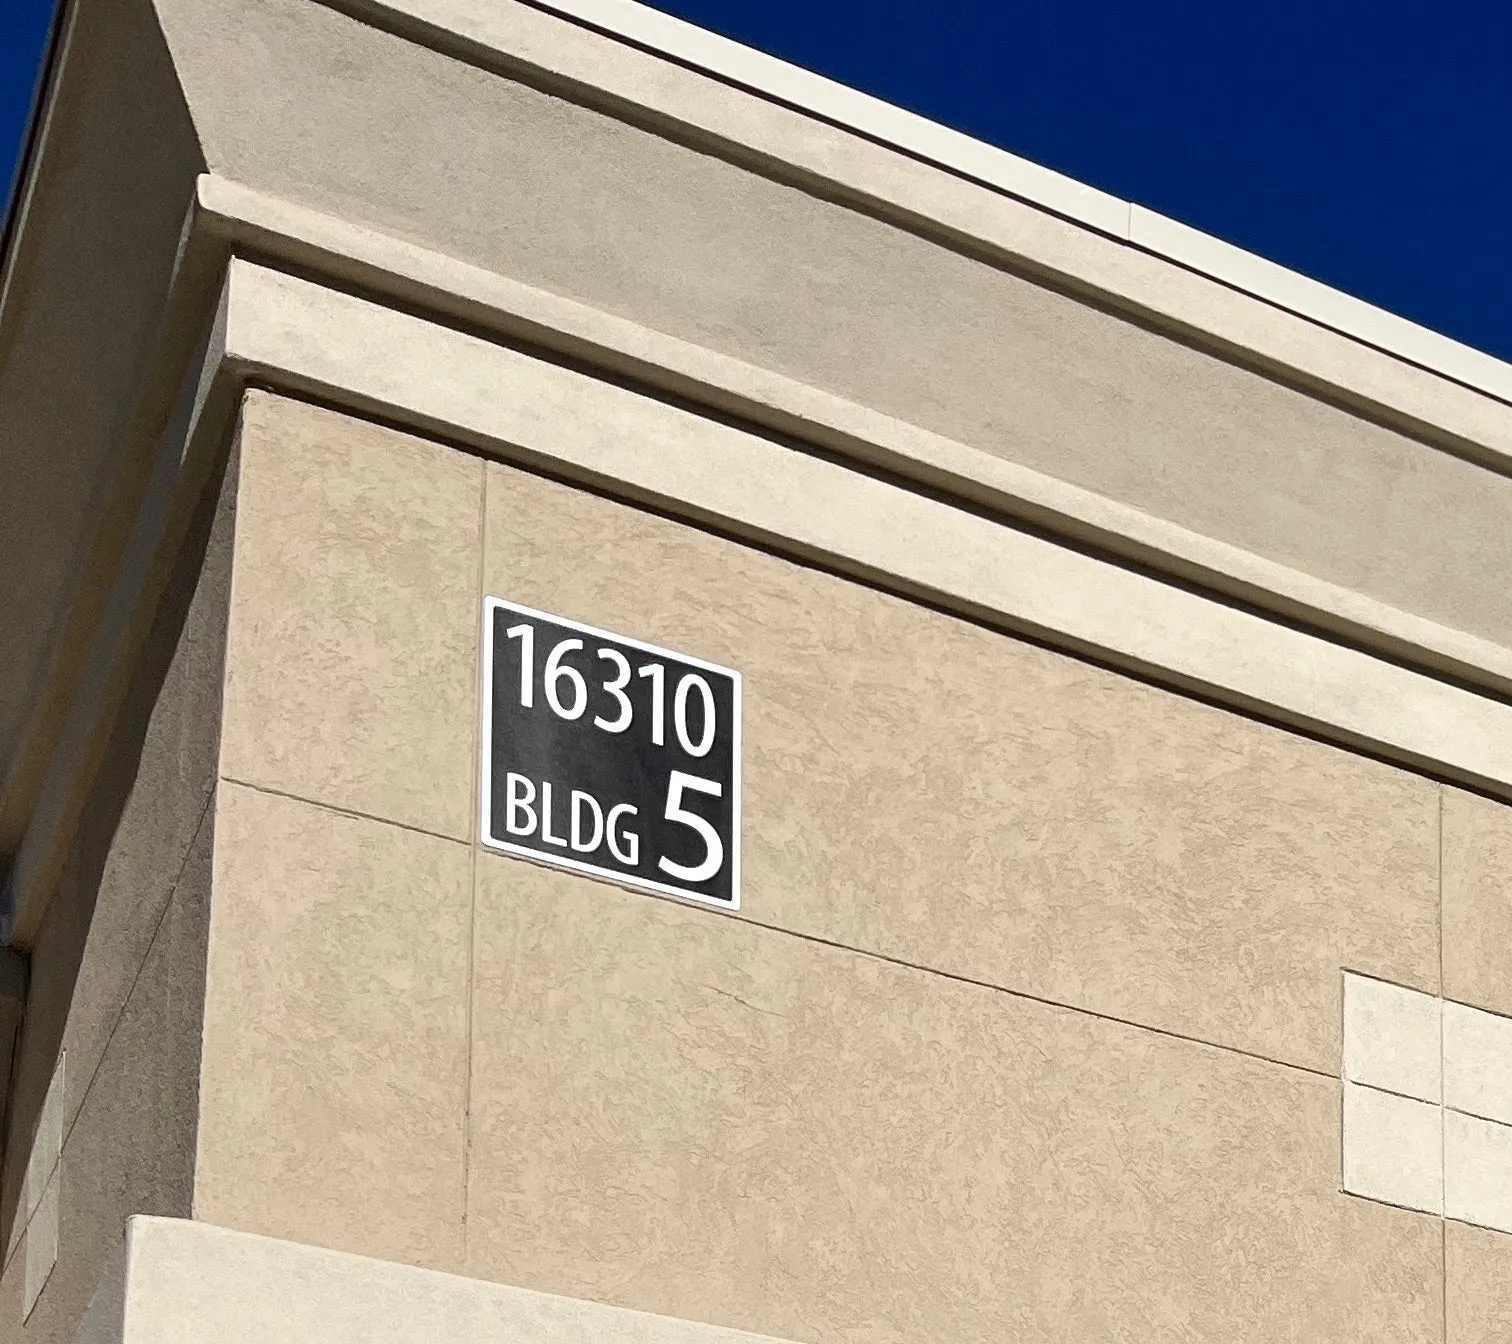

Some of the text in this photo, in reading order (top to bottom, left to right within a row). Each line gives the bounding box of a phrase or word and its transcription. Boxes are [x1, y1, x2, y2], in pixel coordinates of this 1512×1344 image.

[506, 623, 716, 757] 16310
[505, 770, 724, 882] BLDG 5
